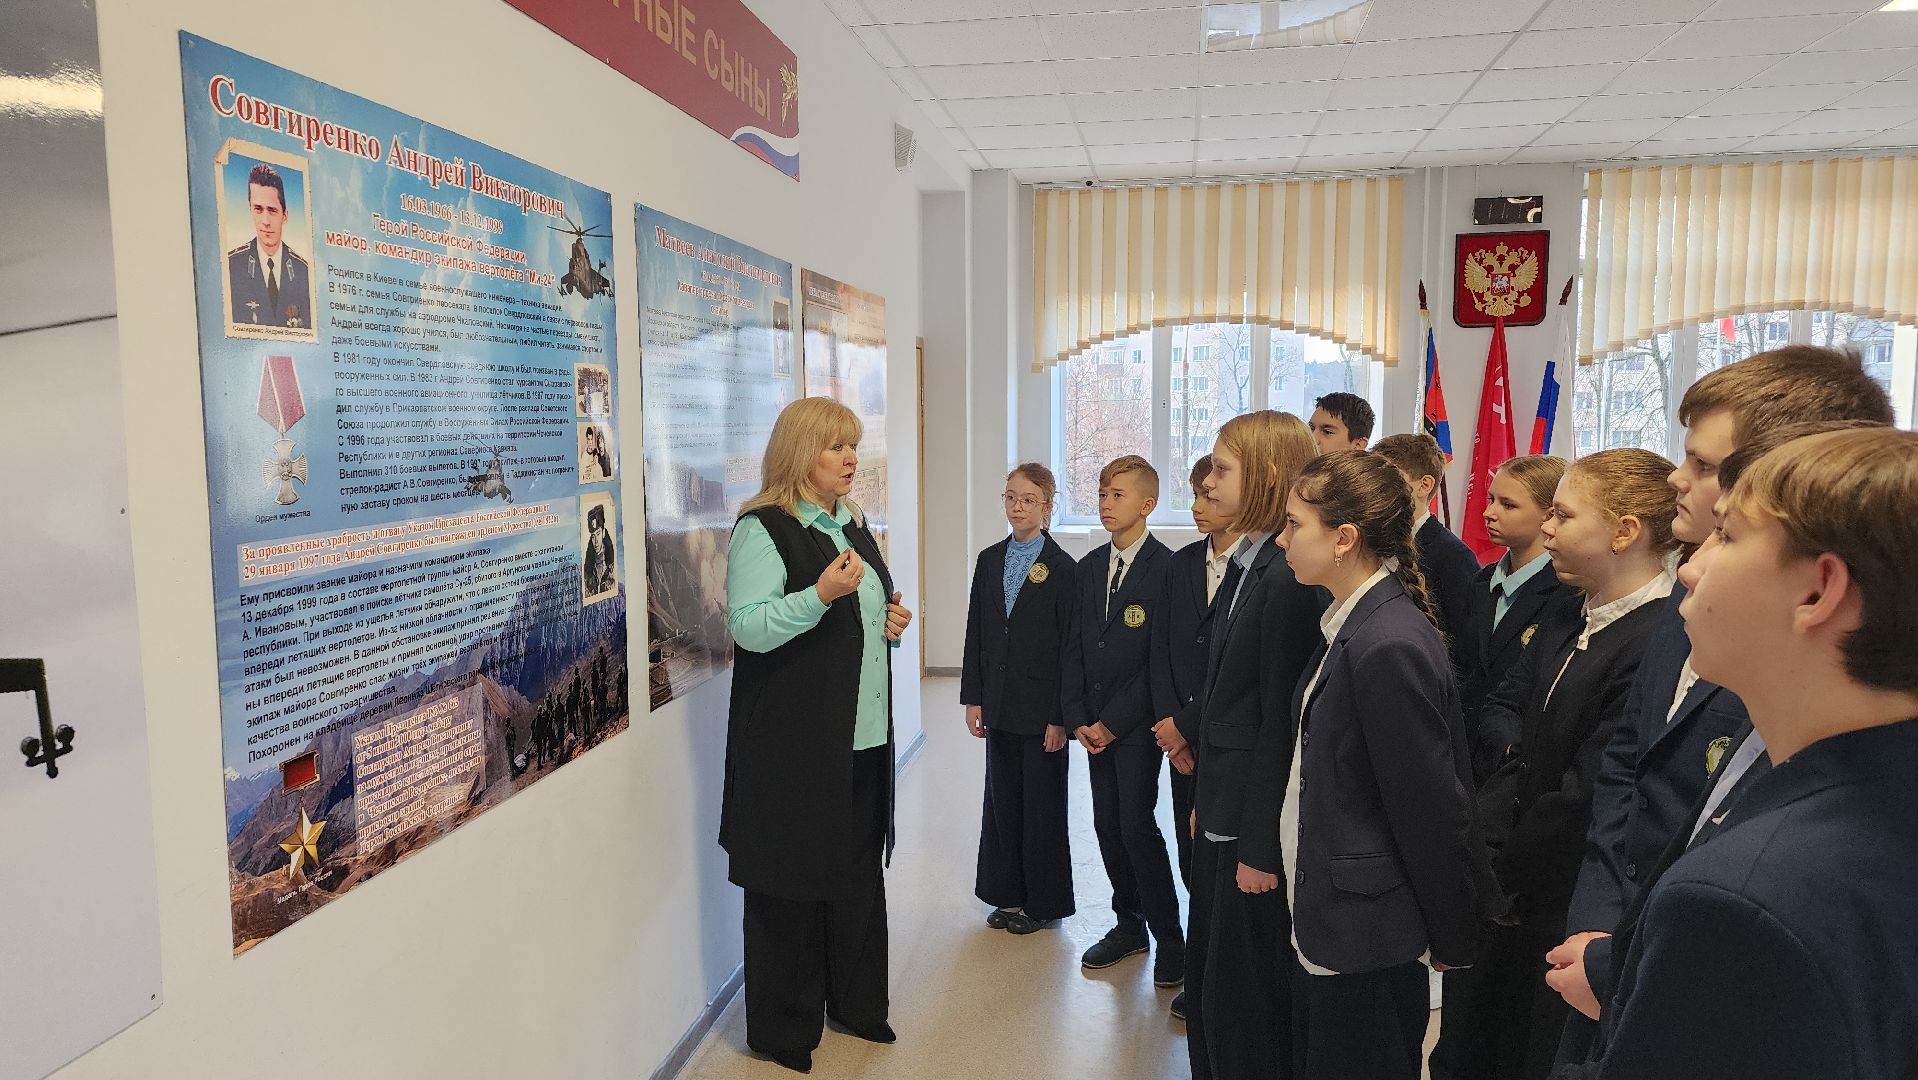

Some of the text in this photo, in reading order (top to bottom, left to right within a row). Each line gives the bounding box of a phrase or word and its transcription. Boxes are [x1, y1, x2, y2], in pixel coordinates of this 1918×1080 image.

[703, 28, 772, 121] СЫНЫ
[208, 69, 564, 219] Совгиренко Андрей Викторович
[372, 213, 409, 238] Герой
[410, 222, 472, 251] Российской
[654, 224, 694, 258] Матвеев
[324, 229, 555, 288] майор, командир экипажа вертолёта "Ми-24"
[327, 263, 364, 280] Родился
[373, 271, 396, 285] Киеве
[405, 279, 427, 290] семье
[337, 283, 357, 295] 1976
[366, 290, 389, 300] семья
[329, 301, 494, 328] семьи для службы аэродроме Чкаловский.
[330, 315, 448, 340] Андрей всегда хорошо учился,
[331, 336, 440, 352] даже боевыми искусствами.
[342, 353, 360, 363] 1981
[362, 356, 380, 367] году
[383, 357, 414, 366] окончил
[346, 388, 467, 399] высшего военного авиационного
[438, 373, 463, 385] Андрей
[336, 405, 351, 414] дил
[354, 402, 383, 414] службу
[337, 418, 436, 431] Союза продолжил службу
[346, 435, 364, 445] 1996
[366, 436, 384, 446] года
[386, 435, 428, 445] участвовал
[436, 433, 461, 441] боевых
[338, 448, 457, 464] Республики других регионах
[339, 463, 458, 479] Выполнил 310 боевых вылетов.
[340, 482, 401, 497] стрелок-радист
[341, 503, 358, 513] ную
[360, 499, 390, 509] заставу
[392, 496, 418, 507] сроком
[430, 492, 450, 500] шесть
[255, 510, 310, 524] Орден мужества
[242, 531, 369, 560] За проявленные храбрость
[243, 539, 422, 578] 29 января 1997 Андрей Совгиренко
[240, 548, 490, 607] Ему присвоили звание майора назначили командиром экипажа
[241, 564, 471, 623] 13 декабря 1999 года составе группы майор
[242, 572, 497, 641] А. Ивановым, участвовал поиске лётчика самолёта сбитого
[243, 612, 393, 661] республики. При выходе ущелья
[244, 617, 423, 675] впереди летящих вертолетов. Из-за низкой
[244, 617, 479, 693] атаки был невозможен. данной обстановке экипаж принял
[245, 635, 457, 710] ны впереди летящие вертолеты принял основной
[247, 666, 408, 727] экипаж майора Совгиренко спас жизни
[247, 685, 397, 745] качества воинского товарищества.
[248, 701, 392, 762] Похоронен на кладбище деревни
